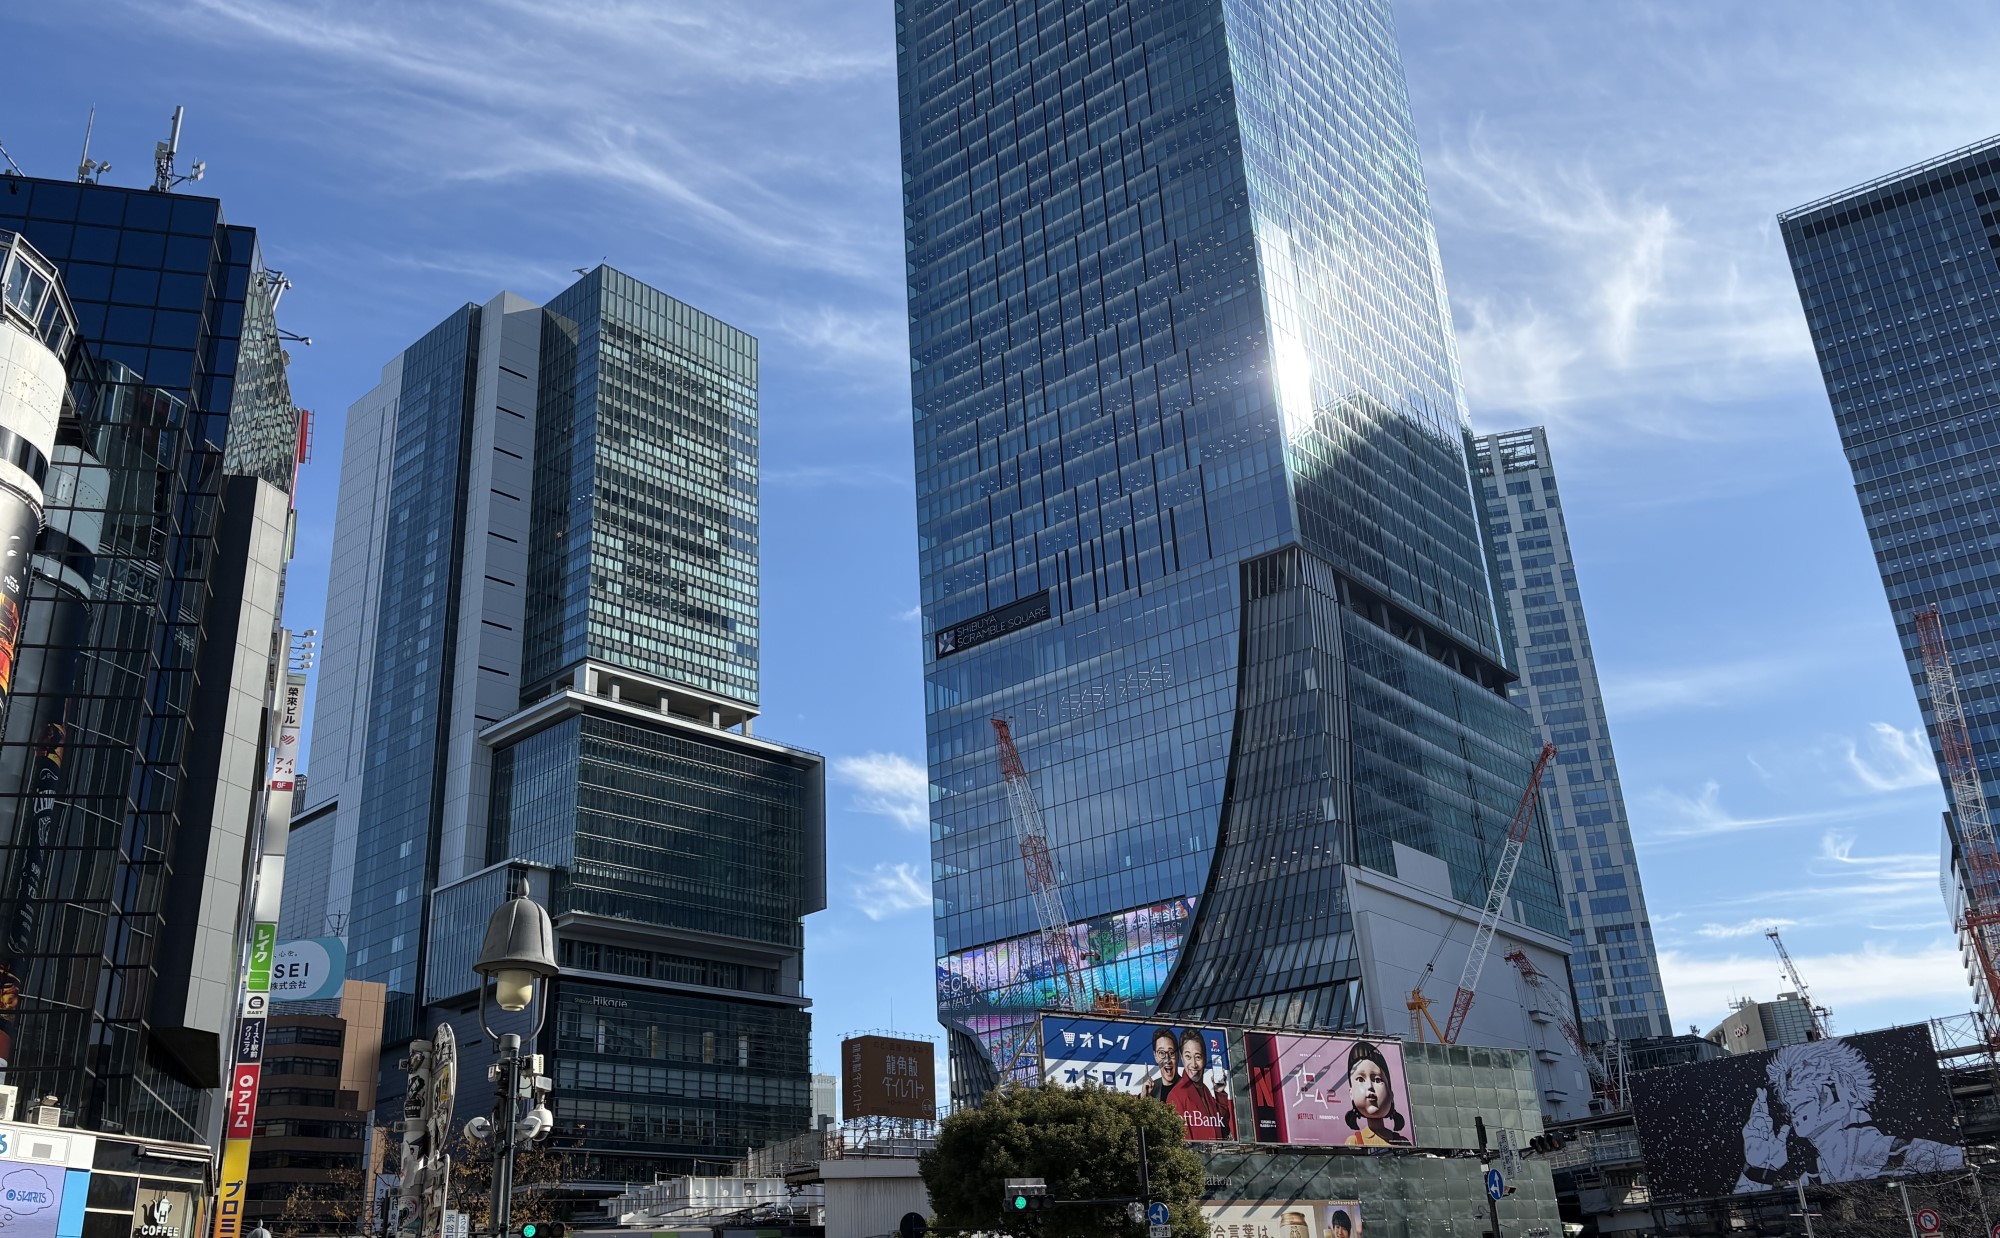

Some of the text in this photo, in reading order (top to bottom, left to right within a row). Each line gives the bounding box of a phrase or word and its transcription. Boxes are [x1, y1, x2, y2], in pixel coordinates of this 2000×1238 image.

[956, 615, 997, 637] SHIBUYA
[957, 605, 1048, 648] SCRAMBLE SQUARE
[254, 929, 270, 963] レイク
[270, 980, 307, 991] 株式会社
[592, 995, 628, 1008] Hikarie
[242, 1025, 253, 1054] クリニック
[249, 1021, 261, 1058] イースト駅前
[1079, 1032, 1130, 1051] オトク
[885, 1054, 918, 1077] 龍角散
[1064, 1067, 1133, 1087] オドロク
[882, 1076, 925, 1100] ダイレクト
[1253, 1066, 1275, 1108] N
[234, 1090, 252, 1128] アコム
[1178, 1110, 1226, 1128] ftBank
[219, 1180, 244, 1238] プロミ
[141, 1224, 180, 1237] COFFEE
